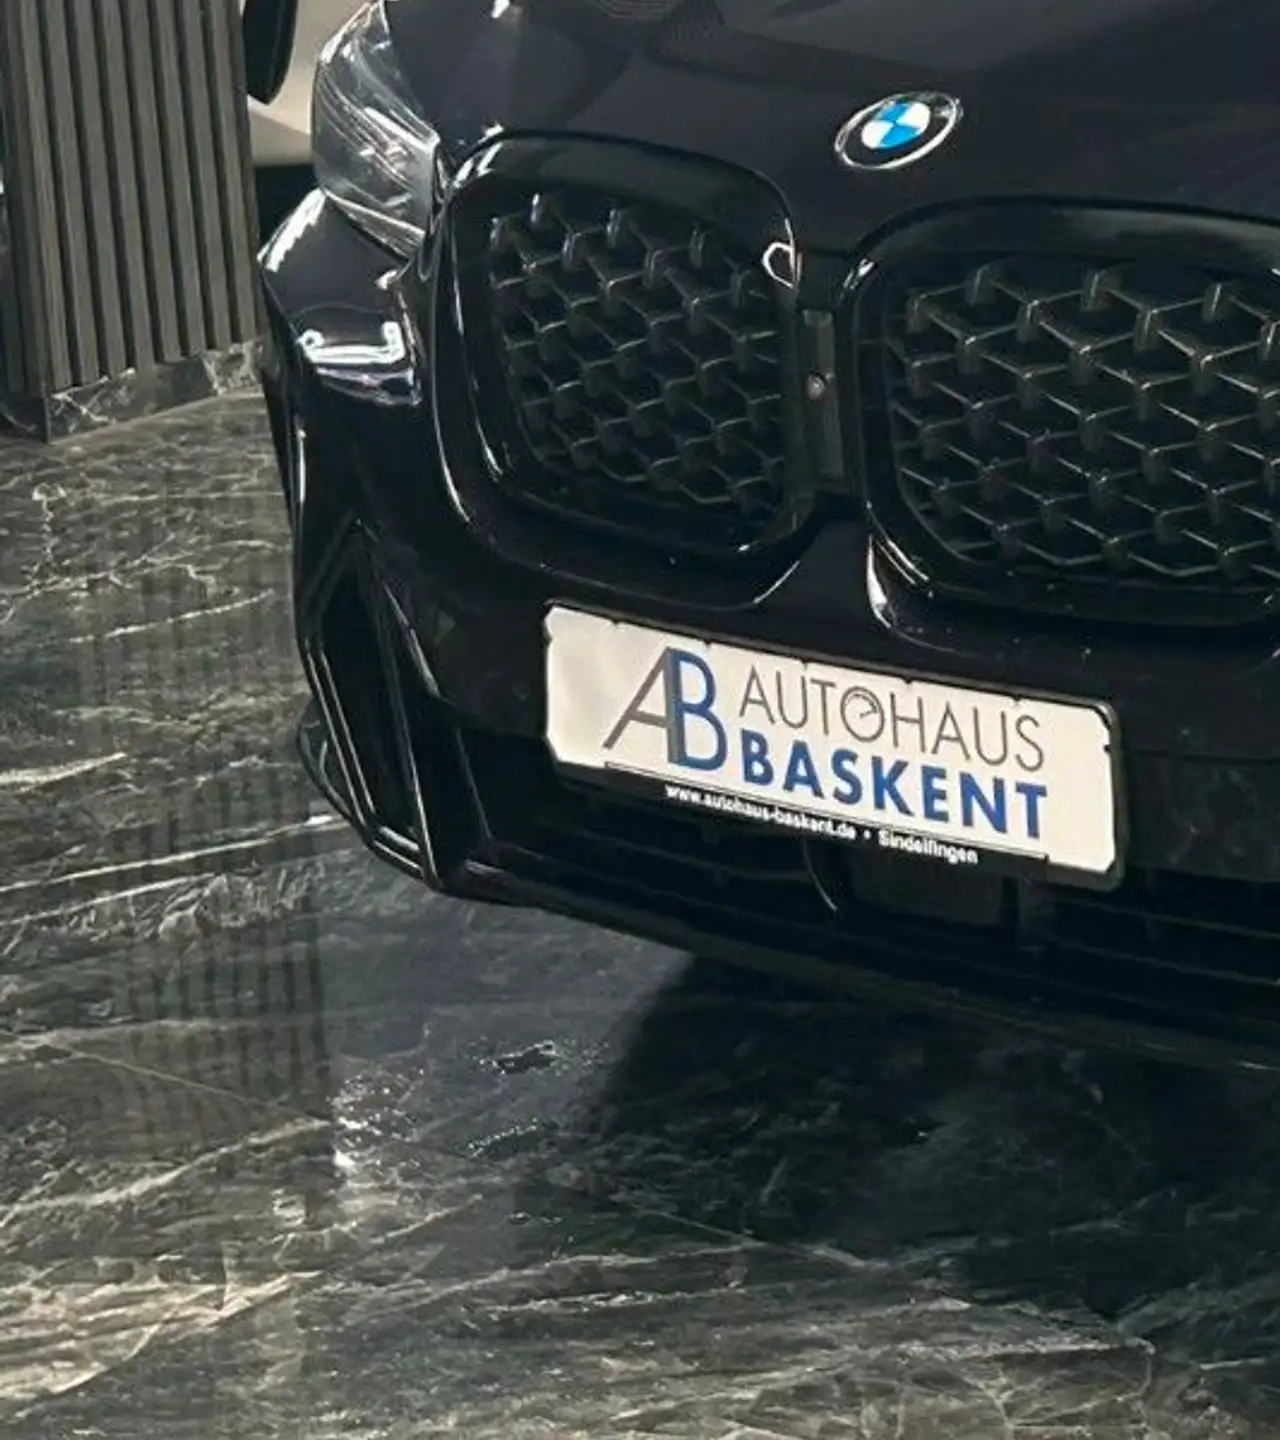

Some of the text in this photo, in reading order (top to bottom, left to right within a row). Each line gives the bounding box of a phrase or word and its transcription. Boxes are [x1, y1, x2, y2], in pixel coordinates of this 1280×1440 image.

[602, 646, 728, 771] AB
[739, 665, 1044, 772] AUTOHAUS
[665, 784, 856, 839] www.autohaus-baskent.de
[878, 828, 979, 865] Sindelfingen
[740, 728, 1047, 839] BASKENT
